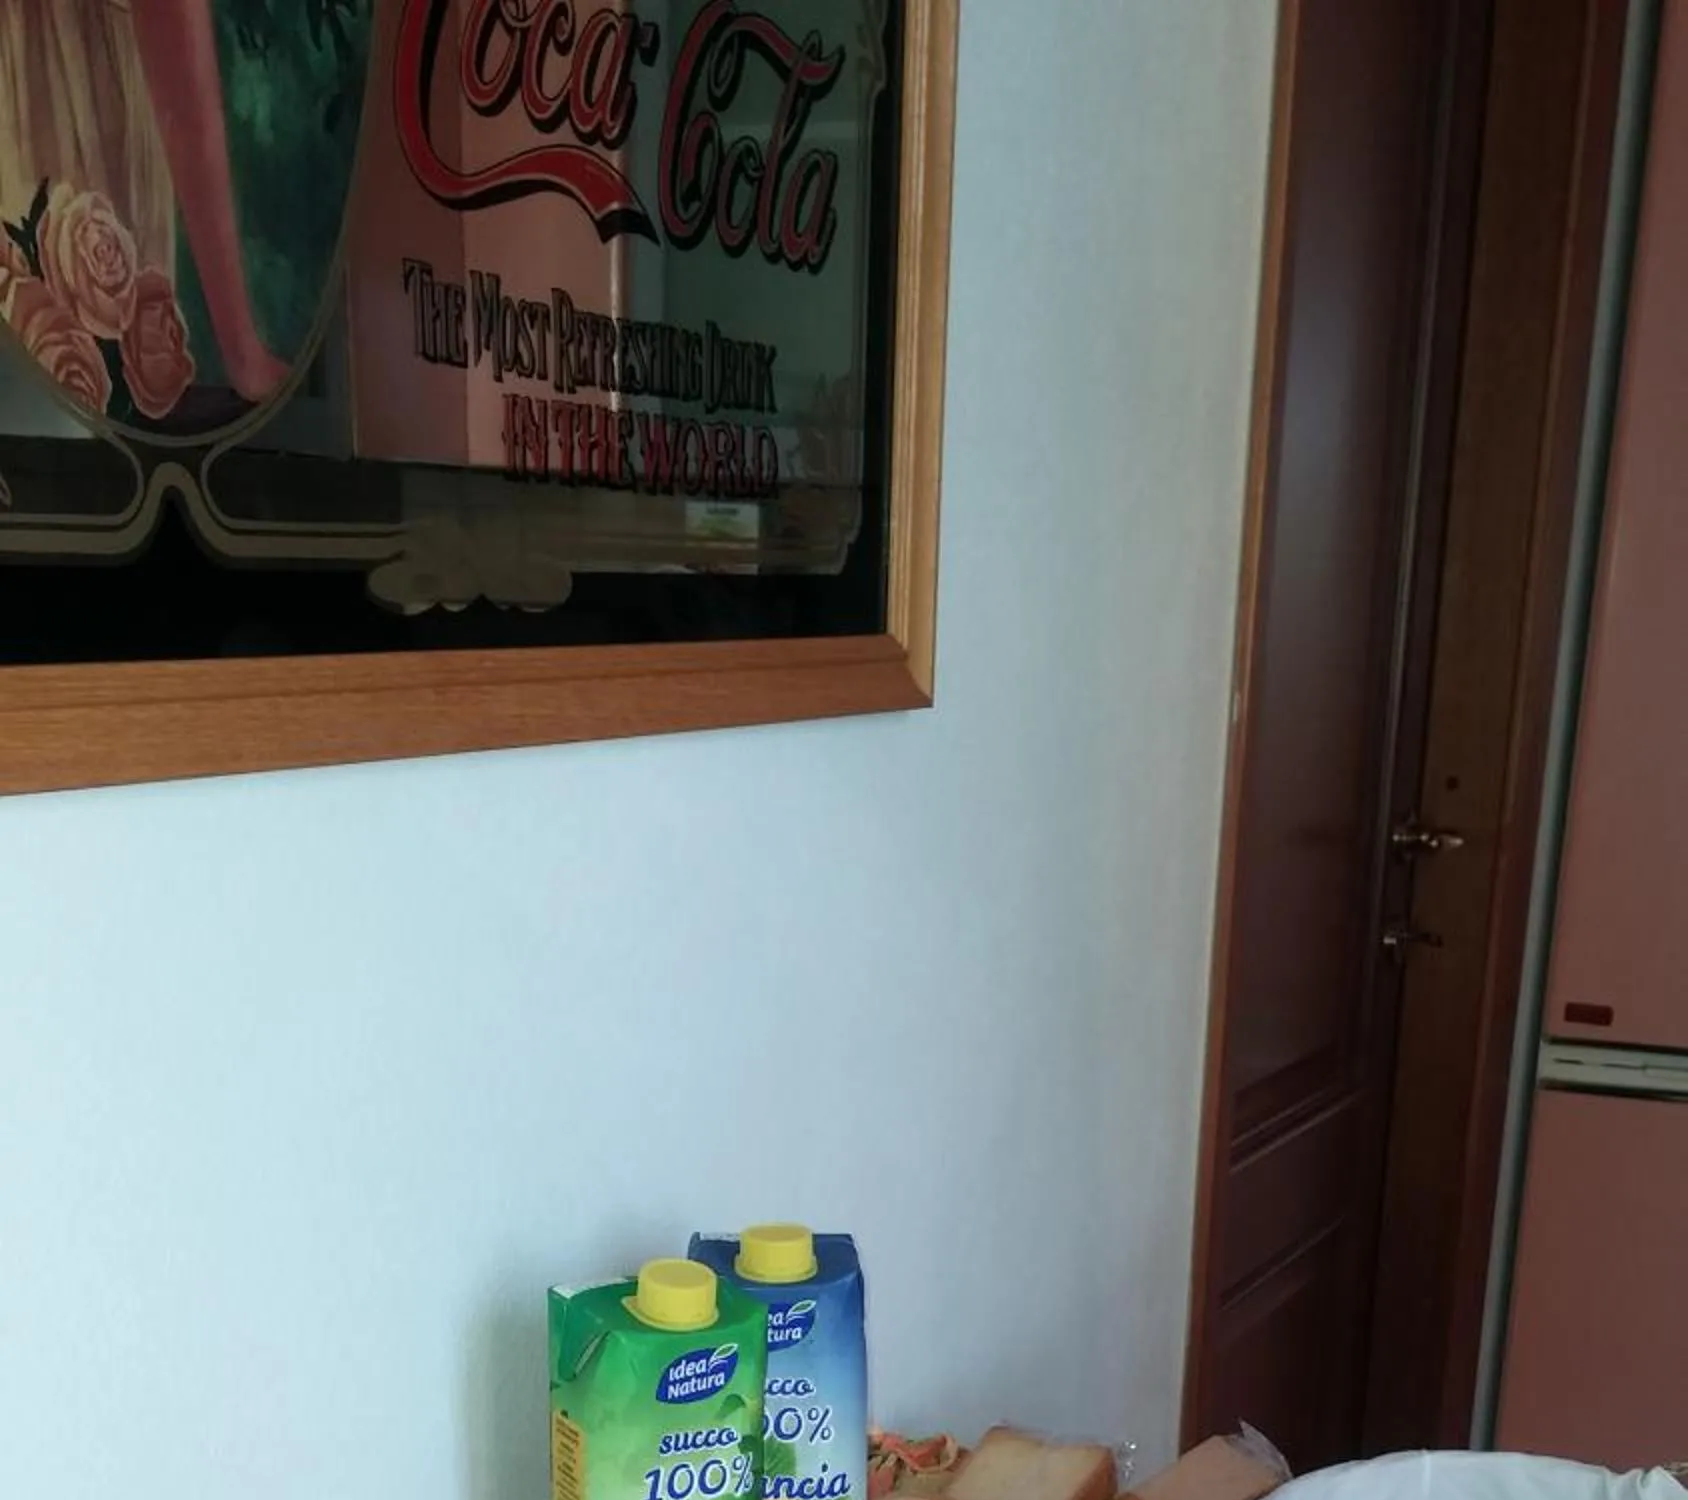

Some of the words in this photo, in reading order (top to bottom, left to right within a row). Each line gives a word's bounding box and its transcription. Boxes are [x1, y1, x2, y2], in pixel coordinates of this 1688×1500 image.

[502, 393, 548, 483] IN
[551, 399, 638, 493] THE
[638, 411, 779, 499] WORLD
[767, 1326, 802, 1343] tura
[667, 1372, 725, 1400] Natura
[763, 1378, 815, 1397] cco
[763, 1406, 832, 1443] 0%
[659, 1427, 738, 1454] succo
[760, 1462, 851, 1500] ncia
